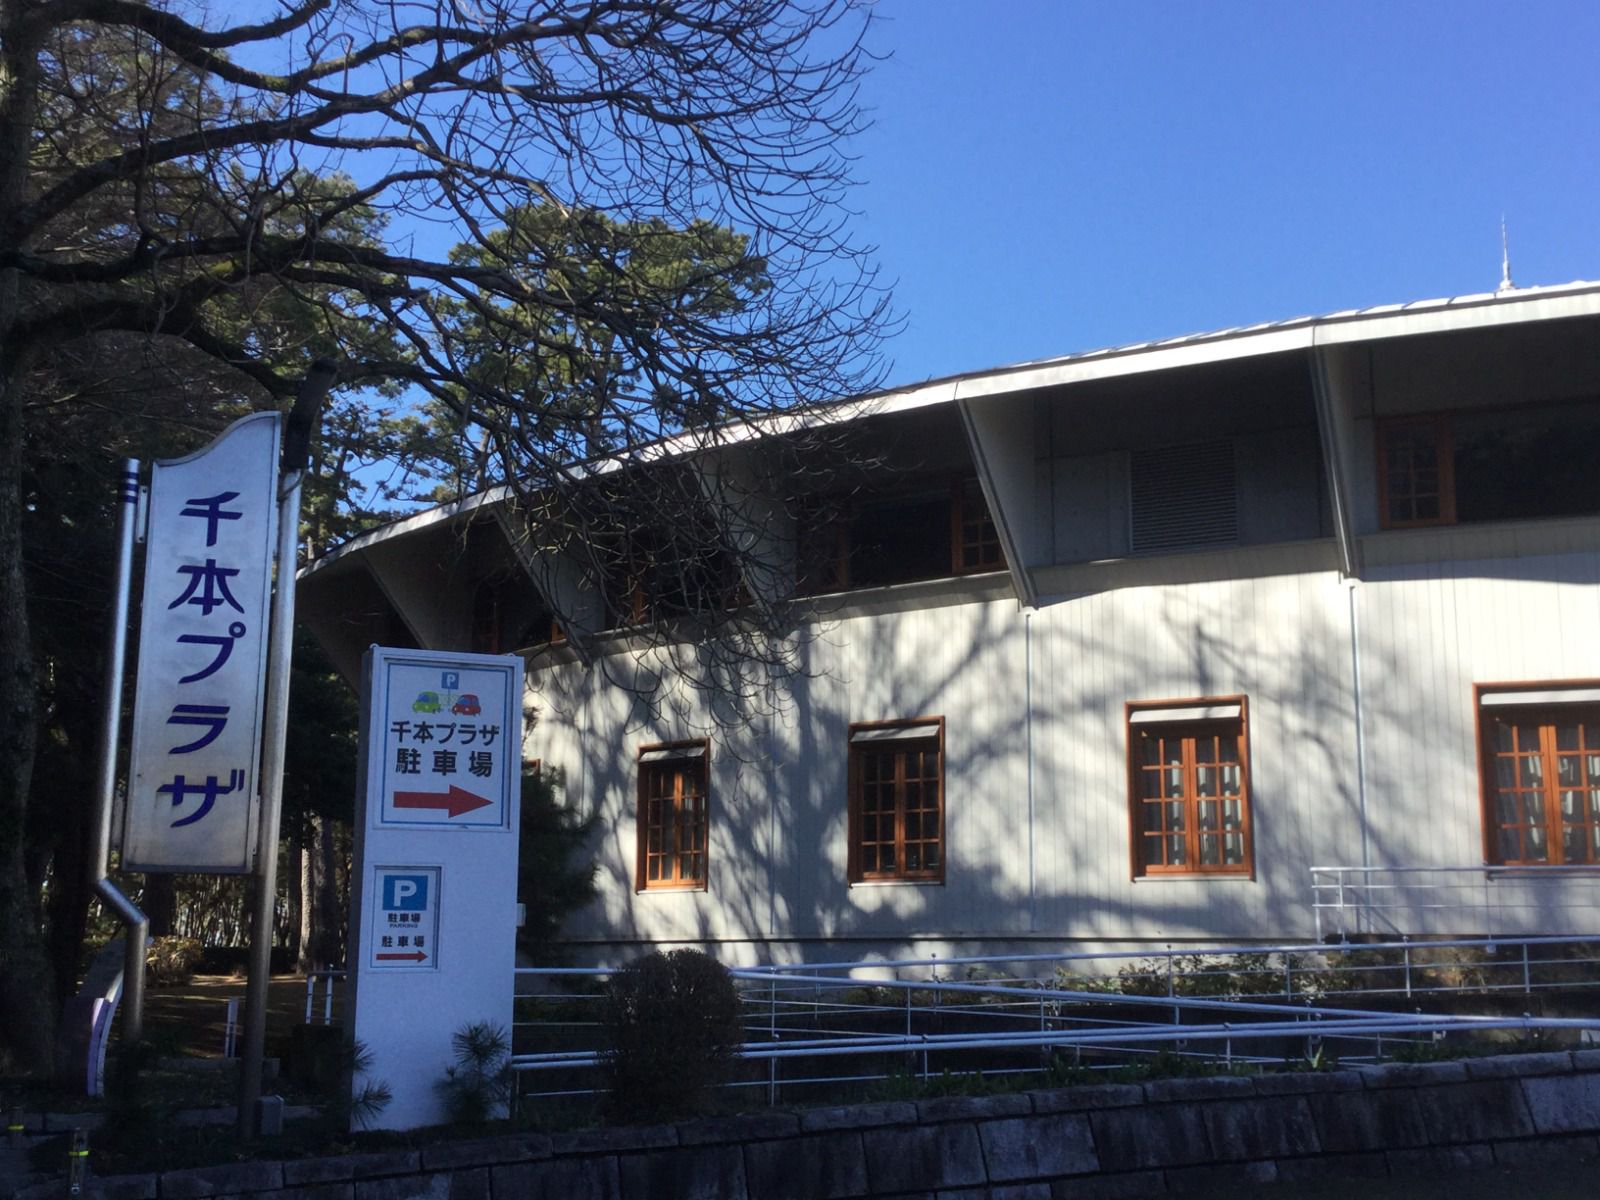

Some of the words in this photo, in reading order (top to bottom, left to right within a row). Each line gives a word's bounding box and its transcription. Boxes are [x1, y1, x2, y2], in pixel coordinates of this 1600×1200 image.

[156, 491, 246, 828] 千本プラザ
[447, 674, 456, 687] P
[390, 720, 500, 746] 千本プラザ
[395, 747, 493, 778] 駐車場
[393, 880, 417, 907] P
[388, 913, 421, 923] 駐車場
[381, 935, 425, 948] 駐車場
